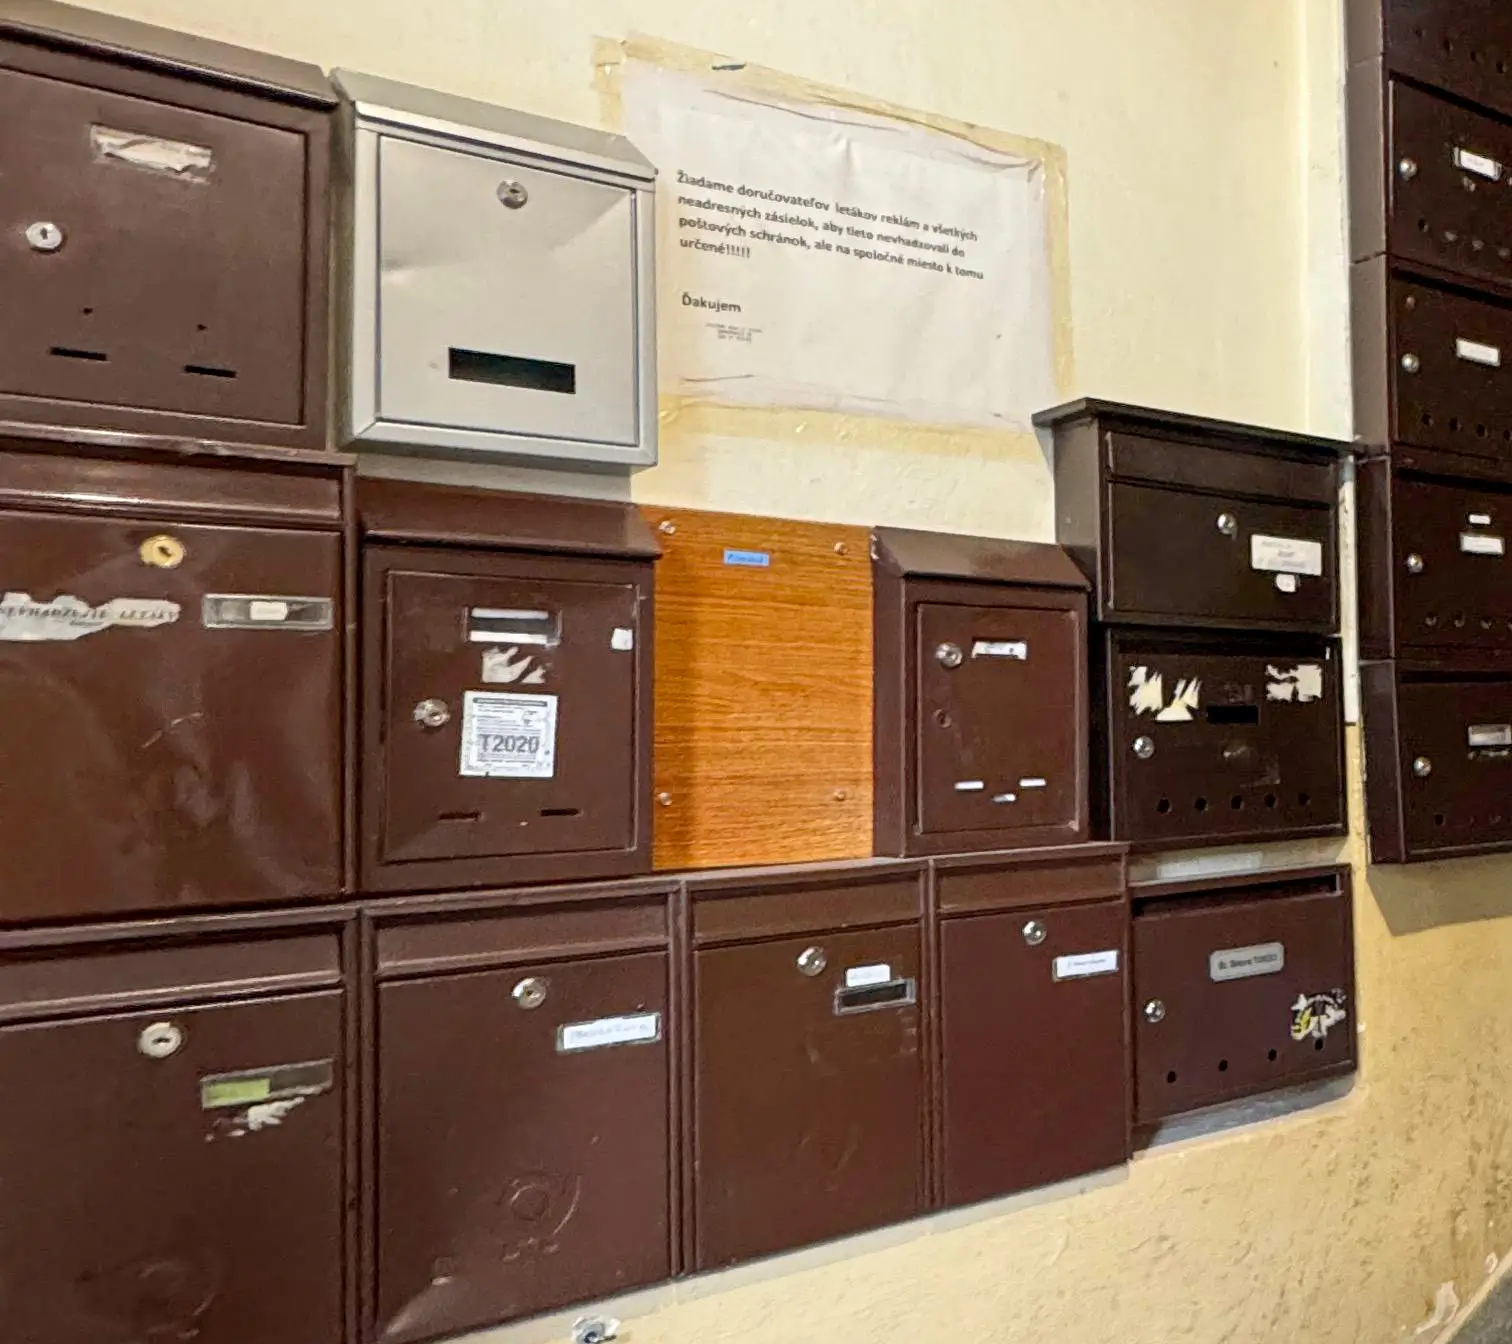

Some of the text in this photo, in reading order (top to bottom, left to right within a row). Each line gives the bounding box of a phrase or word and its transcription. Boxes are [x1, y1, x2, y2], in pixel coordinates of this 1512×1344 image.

[676, 169, 734, 193] Žiadame
[737, 184, 830, 212] doručovateľov
[835, 201, 878, 222] letákov
[881, 213, 920, 230] reklám
[932, 224, 978, 242] všetkých
[678, 195, 966, 258] neadresných zásielok, aby tieto nevhadzovali do
[679, 216, 747, 238] poštových
[750, 229, 811, 250] schránok,
[814, 239, 833, 252] ale
[836, 244, 851, 255] na
[853, 247, 904, 265] spoločné
[907, 257, 944, 273] miesto
[955, 266, 984, 281] tomu
[682, 291, 742, 313] Ďakujem
